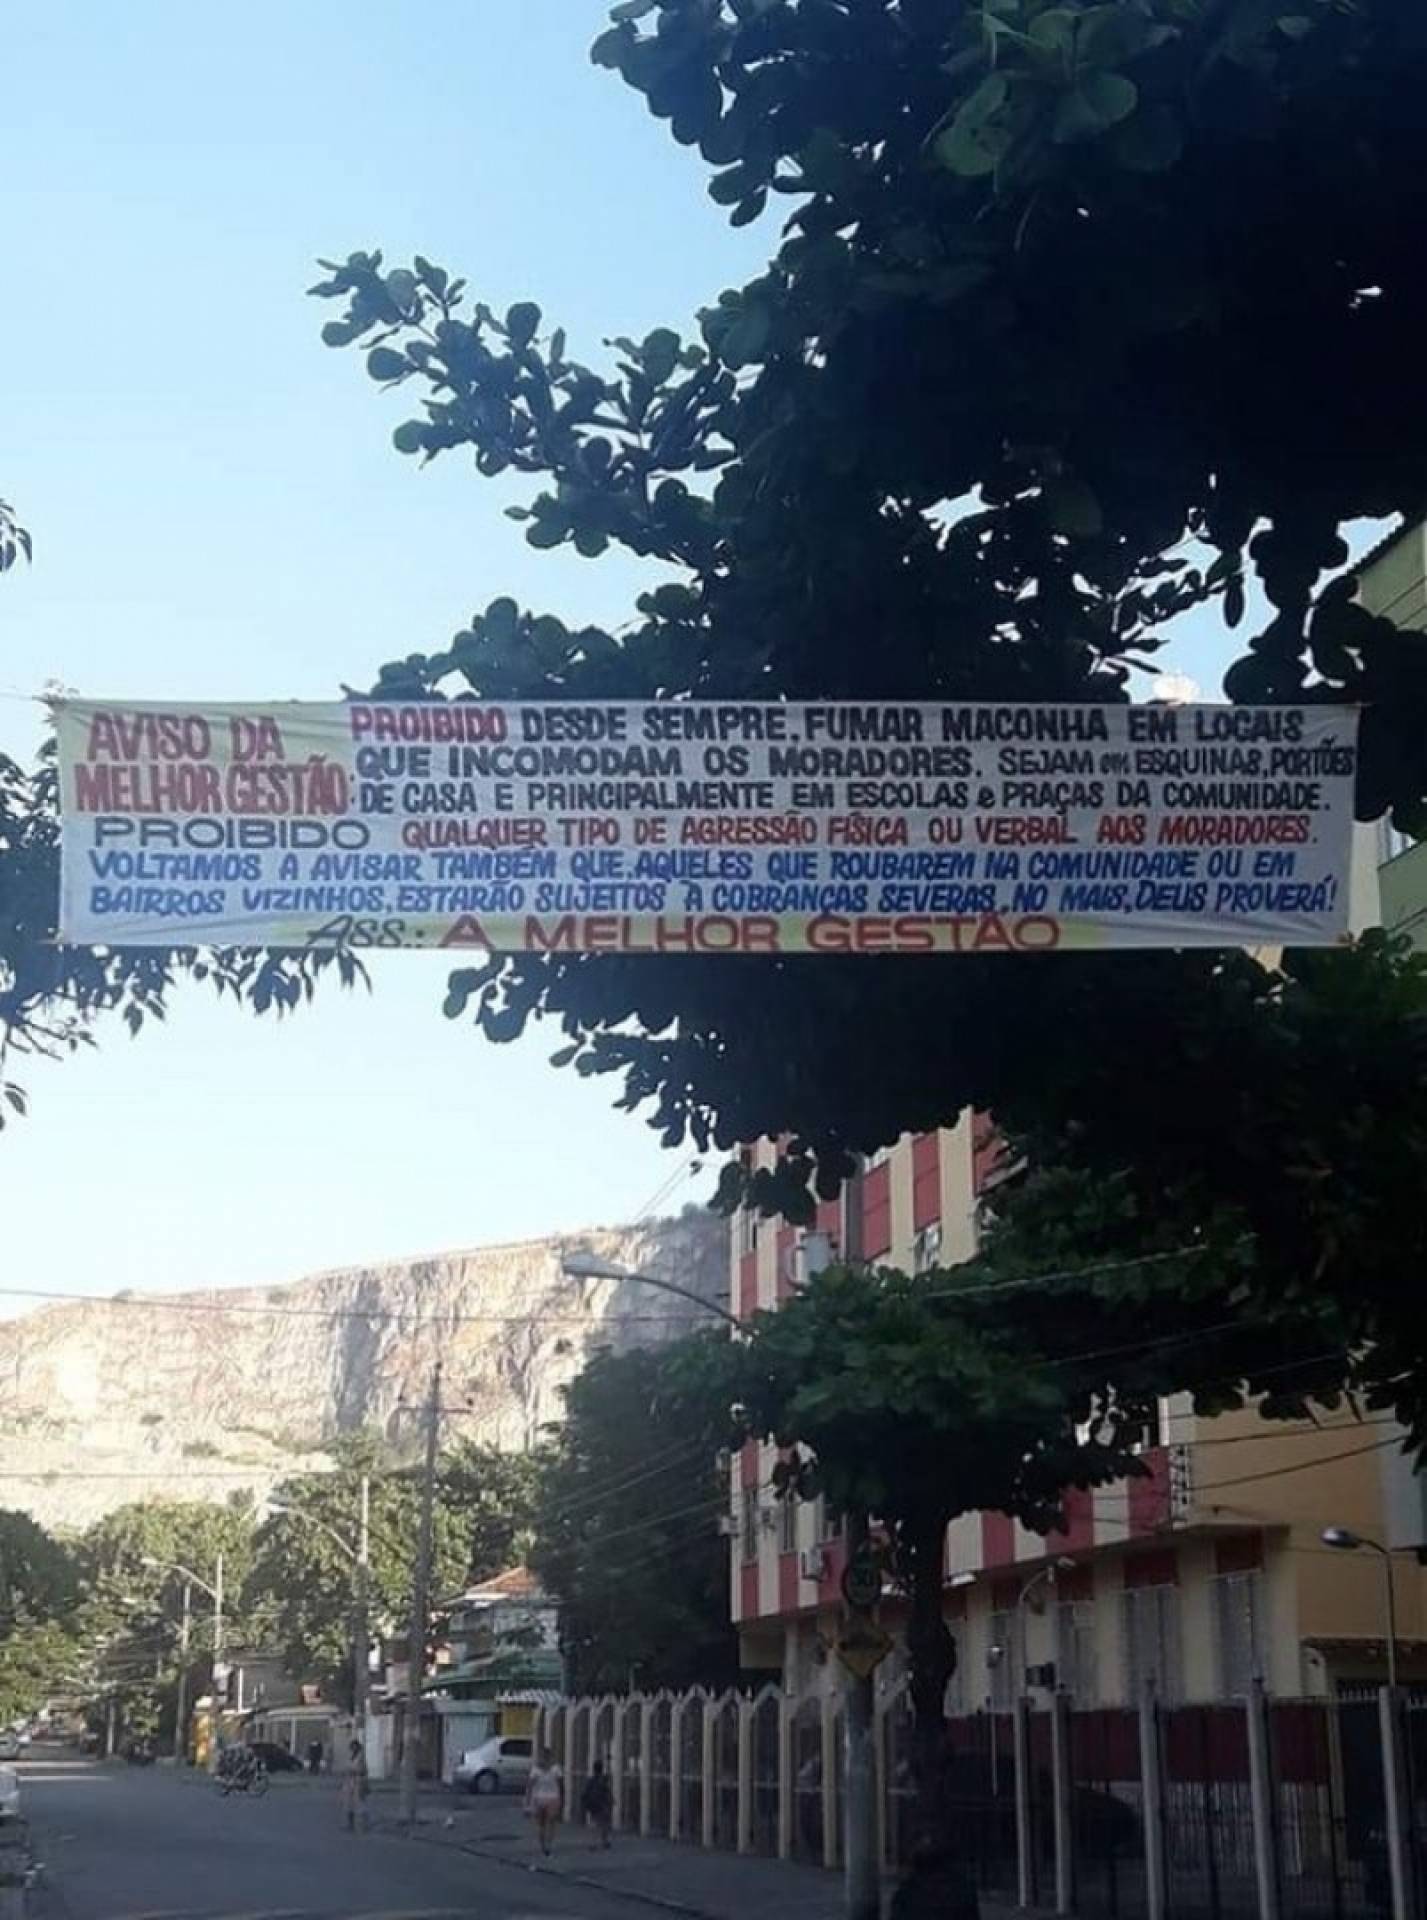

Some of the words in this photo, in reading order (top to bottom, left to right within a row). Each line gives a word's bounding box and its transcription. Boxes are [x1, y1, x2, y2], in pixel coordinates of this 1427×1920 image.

[87, 713, 212, 761] AVISO
[229, 716, 284, 761] DA
[351, 706, 508, 743] PROIBIDO
[521, 707, 627, 742] DESDE
[804, 707, 923, 742] FUMAR
[941, 708, 1108, 742] MACONHA
[1128, 709, 1177, 743] EM
[1195, 710, 1303, 742] LOCAIS
[356, 746, 432, 781] QUE
[449, 747, 682, 777] INCOMODAM
[703, 747, 749, 777] OS
[998, 748, 1094, 775] SEJAM
[74, 763, 225, 814] MELHOR
[360, 783, 395, 814] DE
[402, 783, 478, 813] CASA
[495, 783, 513, 811] E
[527, 782, 773, 811] PRINCIPALMENTE
[791, 782, 834, 809] EM
[847, 782, 969, 809] ESCOLAS
[1003, 783, 1104, 815] PRAÇAS
[1117, 782, 1152, 808] DA
[1163, 783, 1331, 811] COMUNIDADE.
[94, 818, 370, 850] PROIBIDO
[402, 817, 548, 850] QUALQUER
[557, 818, 620, 847] TIPO
[634, 817, 667, 845] DE
[680, 810, 818, 845] AGRESSÃO
[928, 817, 963, 844] OU
[976, 817, 1078, 846] VERBAL
[1097, 814, 1147, 844] AOS
[89, 850, 261, 880] VOLTAMOS
[279, 853, 299, 881] A
[310, 853, 423, 881] AVISAR
[635, 850, 753, 883] AQUELES
[767, 852, 818, 883] QUE
[830, 852, 976, 881] ROUBAREM
[984, 852, 1019, 880] NA
[1028, 851, 1199, 880] COMUNIDADE
[1207, 851, 1243, 879] OU
[1253, 852, 1296, 879] EM
[89, 886, 226, 917] BAIRROS
[399, 880, 525, 913] ESTARÃO
[535, 882, 667, 912] SUJEITOS
[1012, 883, 1048, 913] NO
[1134, 881, 1208, 912] DEUS
[1213, 874, 1338, 912] PROVERÁ!
[438, 914, 496, 949] A
[523, 915, 780, 949] MELHOR
[805, 912, 1060, 950] GESTÃO
